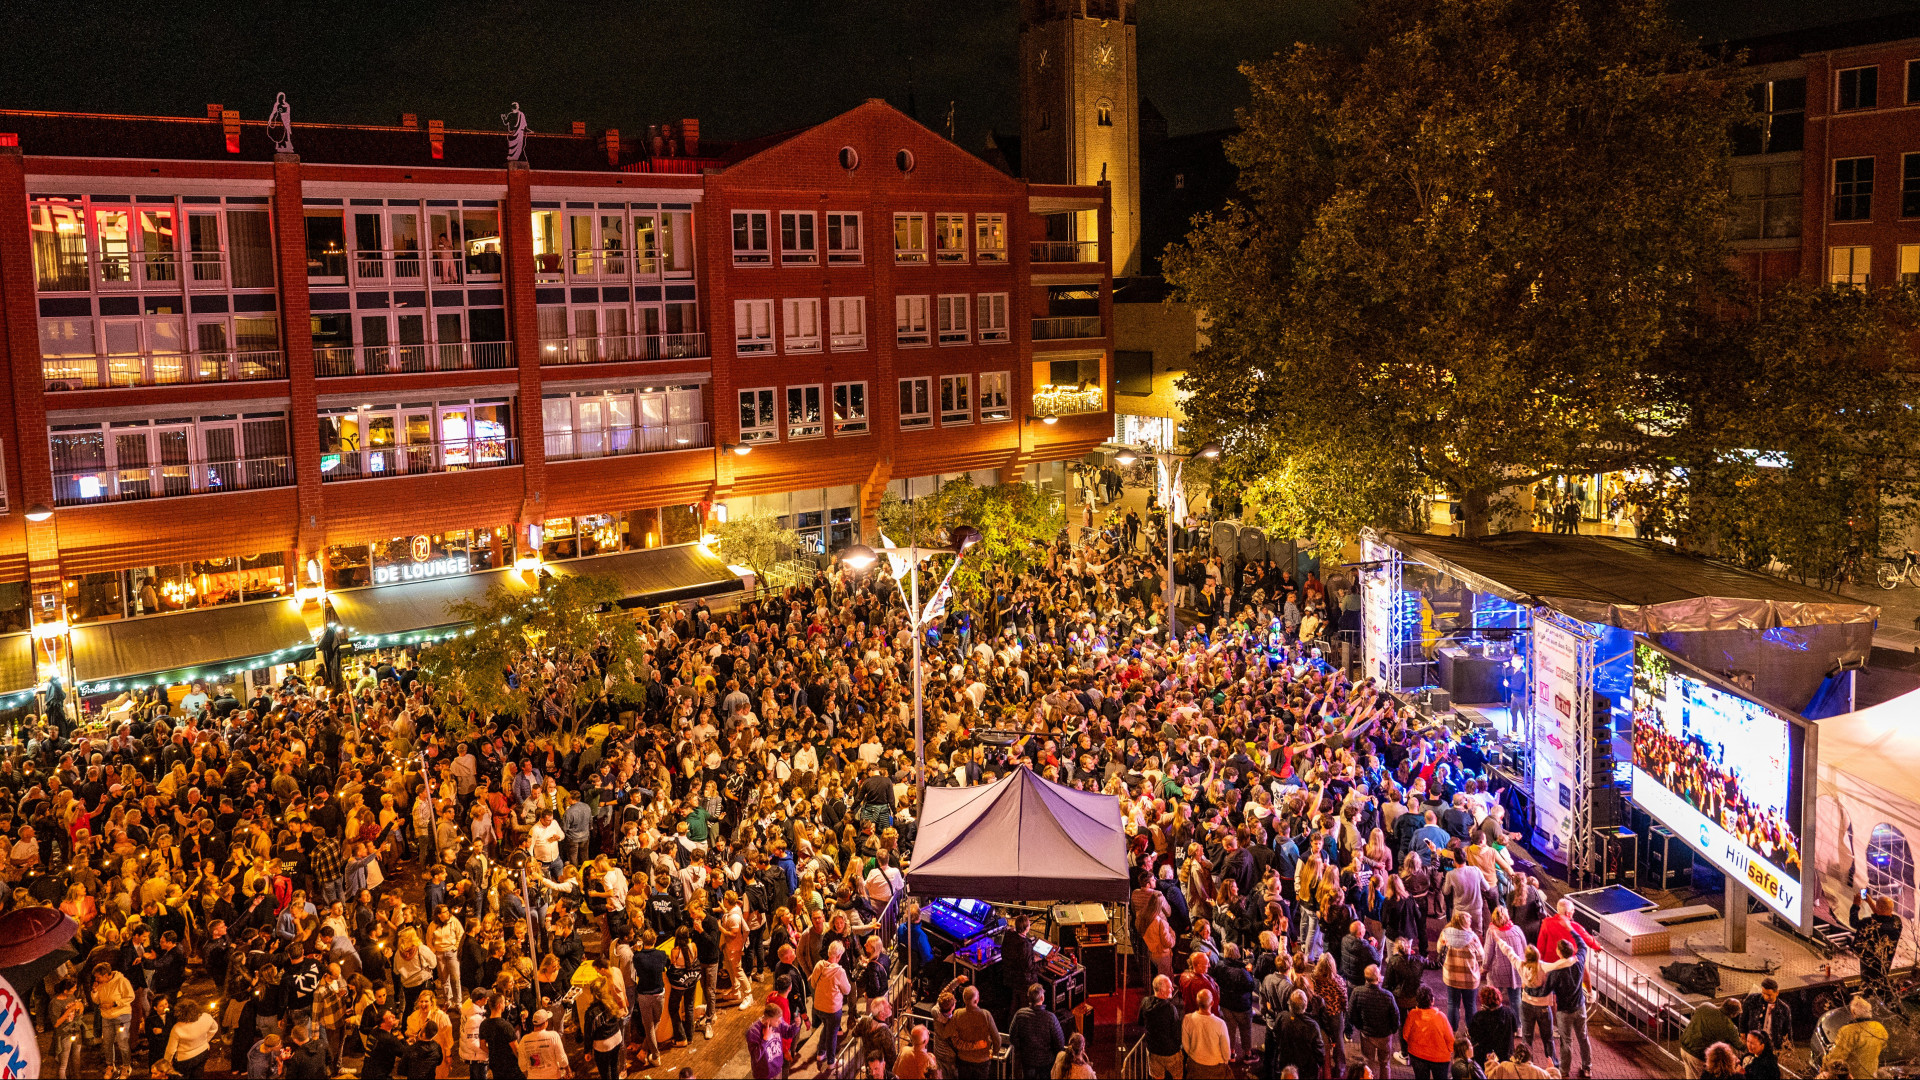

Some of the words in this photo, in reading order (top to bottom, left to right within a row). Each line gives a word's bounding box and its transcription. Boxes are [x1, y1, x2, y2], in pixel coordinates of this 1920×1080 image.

[376, 566, 399, 583] DE
[402, 558, 467, 579] LOUNGE
[1726, 844, 1793, 909] Hillsafety
